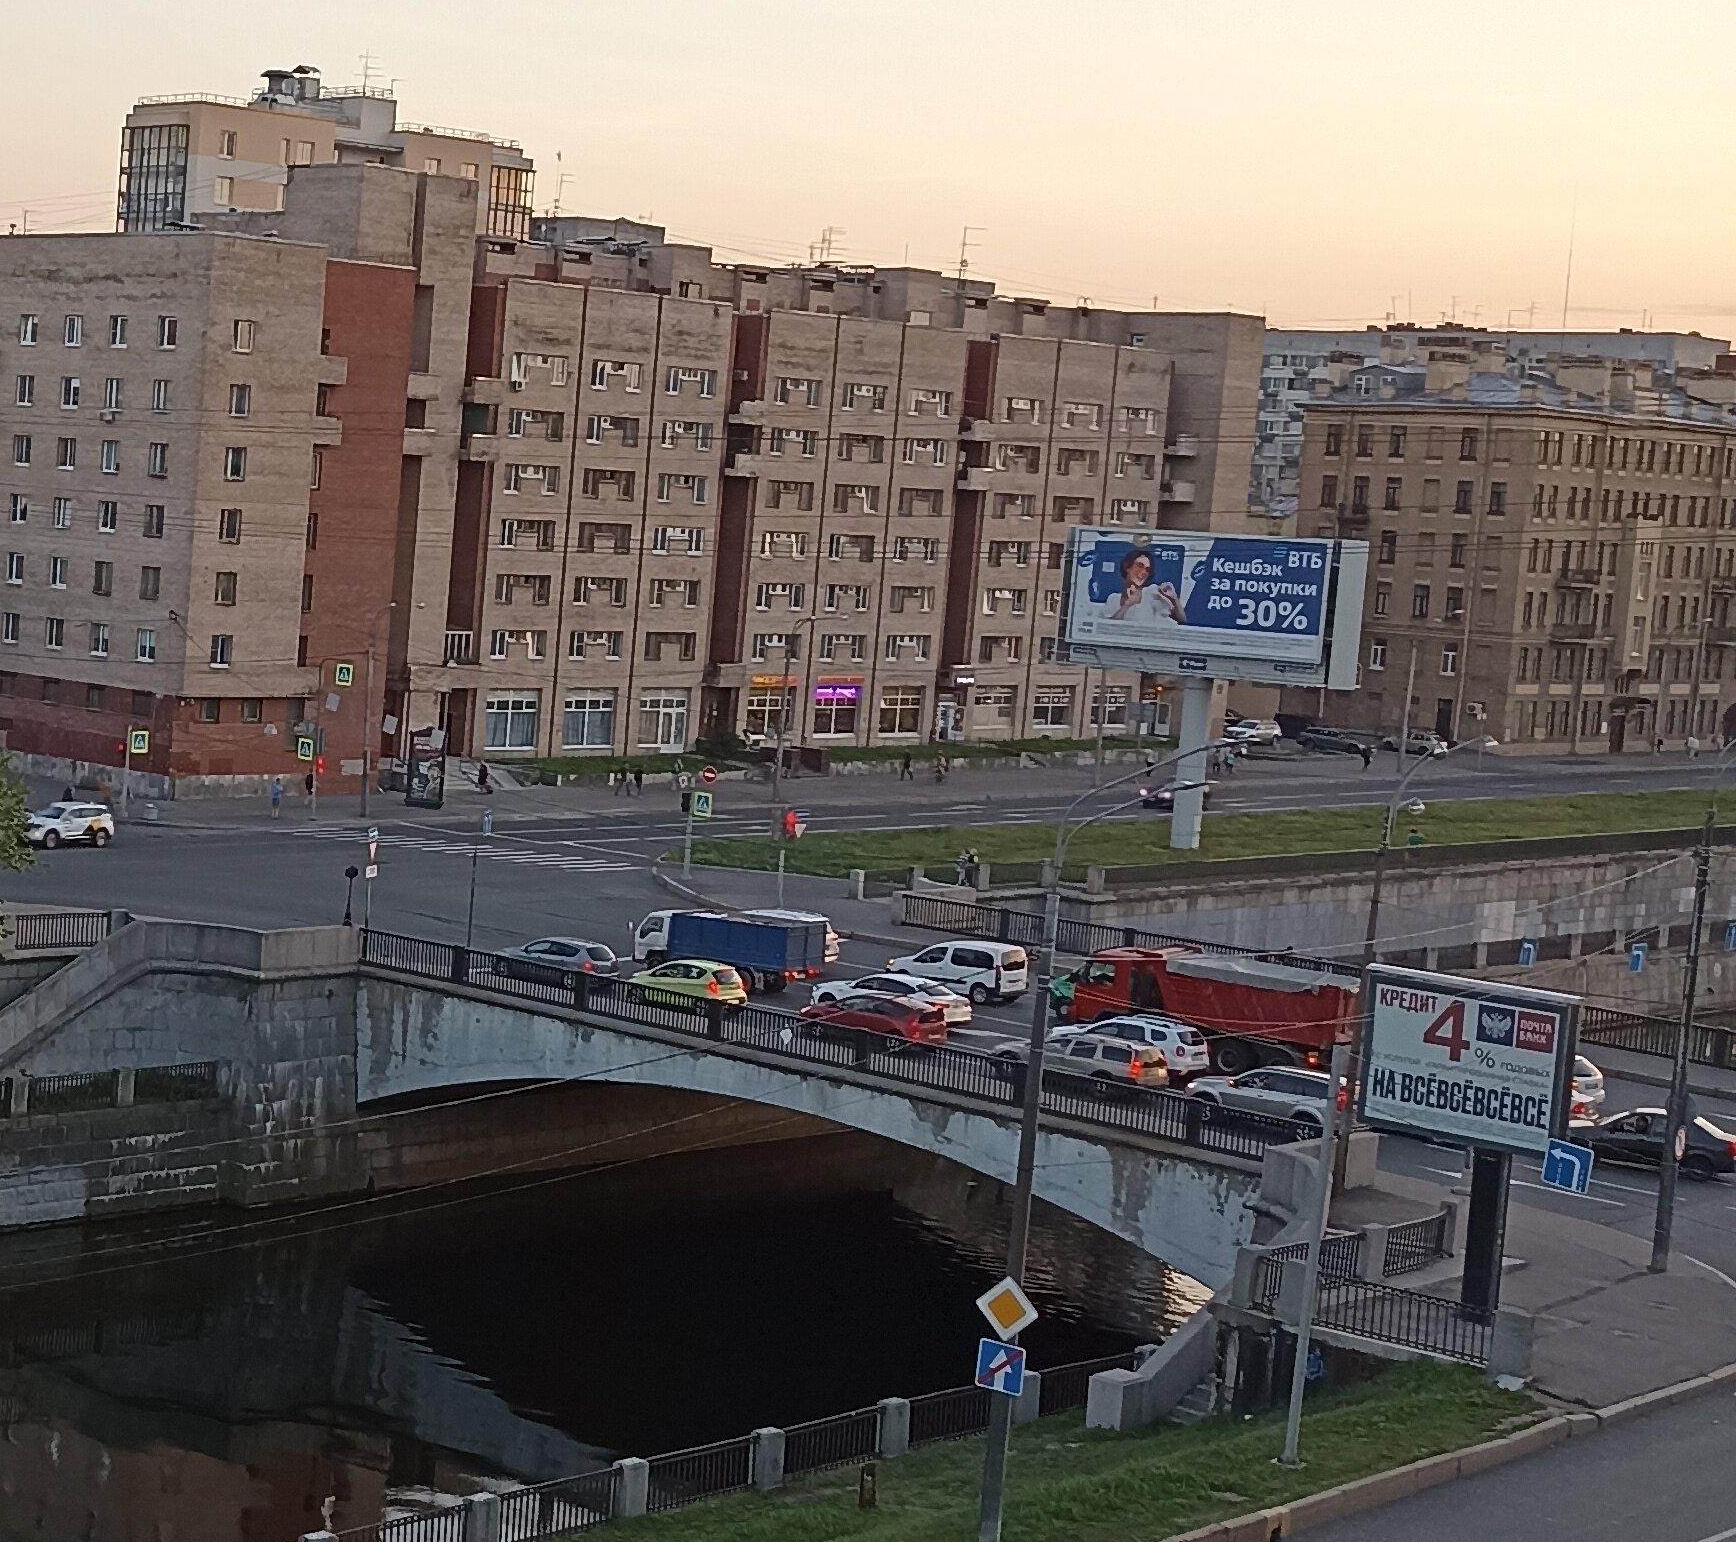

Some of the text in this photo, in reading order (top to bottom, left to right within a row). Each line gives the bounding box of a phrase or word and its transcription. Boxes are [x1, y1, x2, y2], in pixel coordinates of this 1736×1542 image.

[1212, 557, 1283, 577] Кешбэк
[1288, 550, 1323, 569] ВТБ
[1210, 578, 1318, 598] за покупки
[1207, 595, 1308, 630] до 30%
[1380, 987, 1439, 1014] КРЕДИТ
[1423, 999, 1470, 1063] 4
[1519, 1019, 1552, 1034] ПОЧТА
[1519, 1030, 1547, 1044] БАНК
[1372, 1067, 1396, 1101] НА
[1400, 1071, 1549, 1130] ВСЁВСЁВСЁВСЁ
